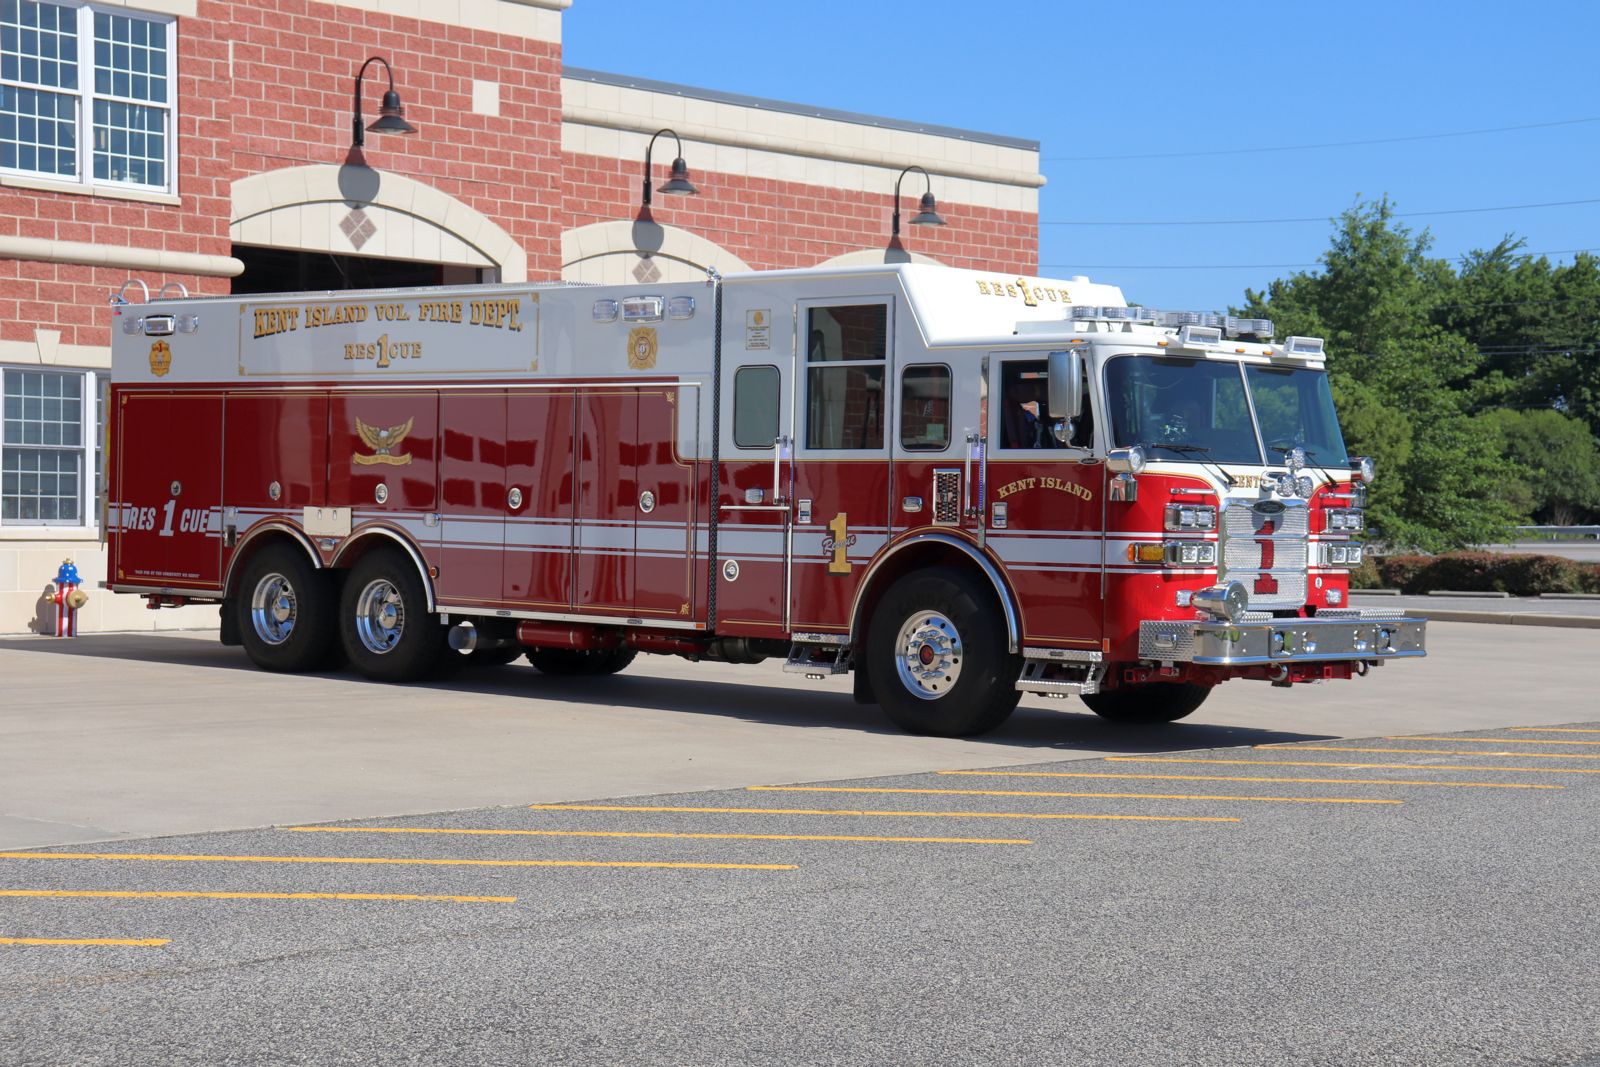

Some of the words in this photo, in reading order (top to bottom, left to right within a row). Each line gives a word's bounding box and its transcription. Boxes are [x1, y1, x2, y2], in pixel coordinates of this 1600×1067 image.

[254, 308, 299, 339] KENT
[305, 304, 368, 328] ISLAND
[375, 303, 411, 321] VOL.
[419, 301, 464, 323] FIRE
[469, 299, 524, 332] DEPT.
[997, 478, 1036, 499] KENT
[1040, 477, 1093, 501] ISLAND
[829, 512, 852, 575] 1
[1254, 520, 1278, 595] 1
